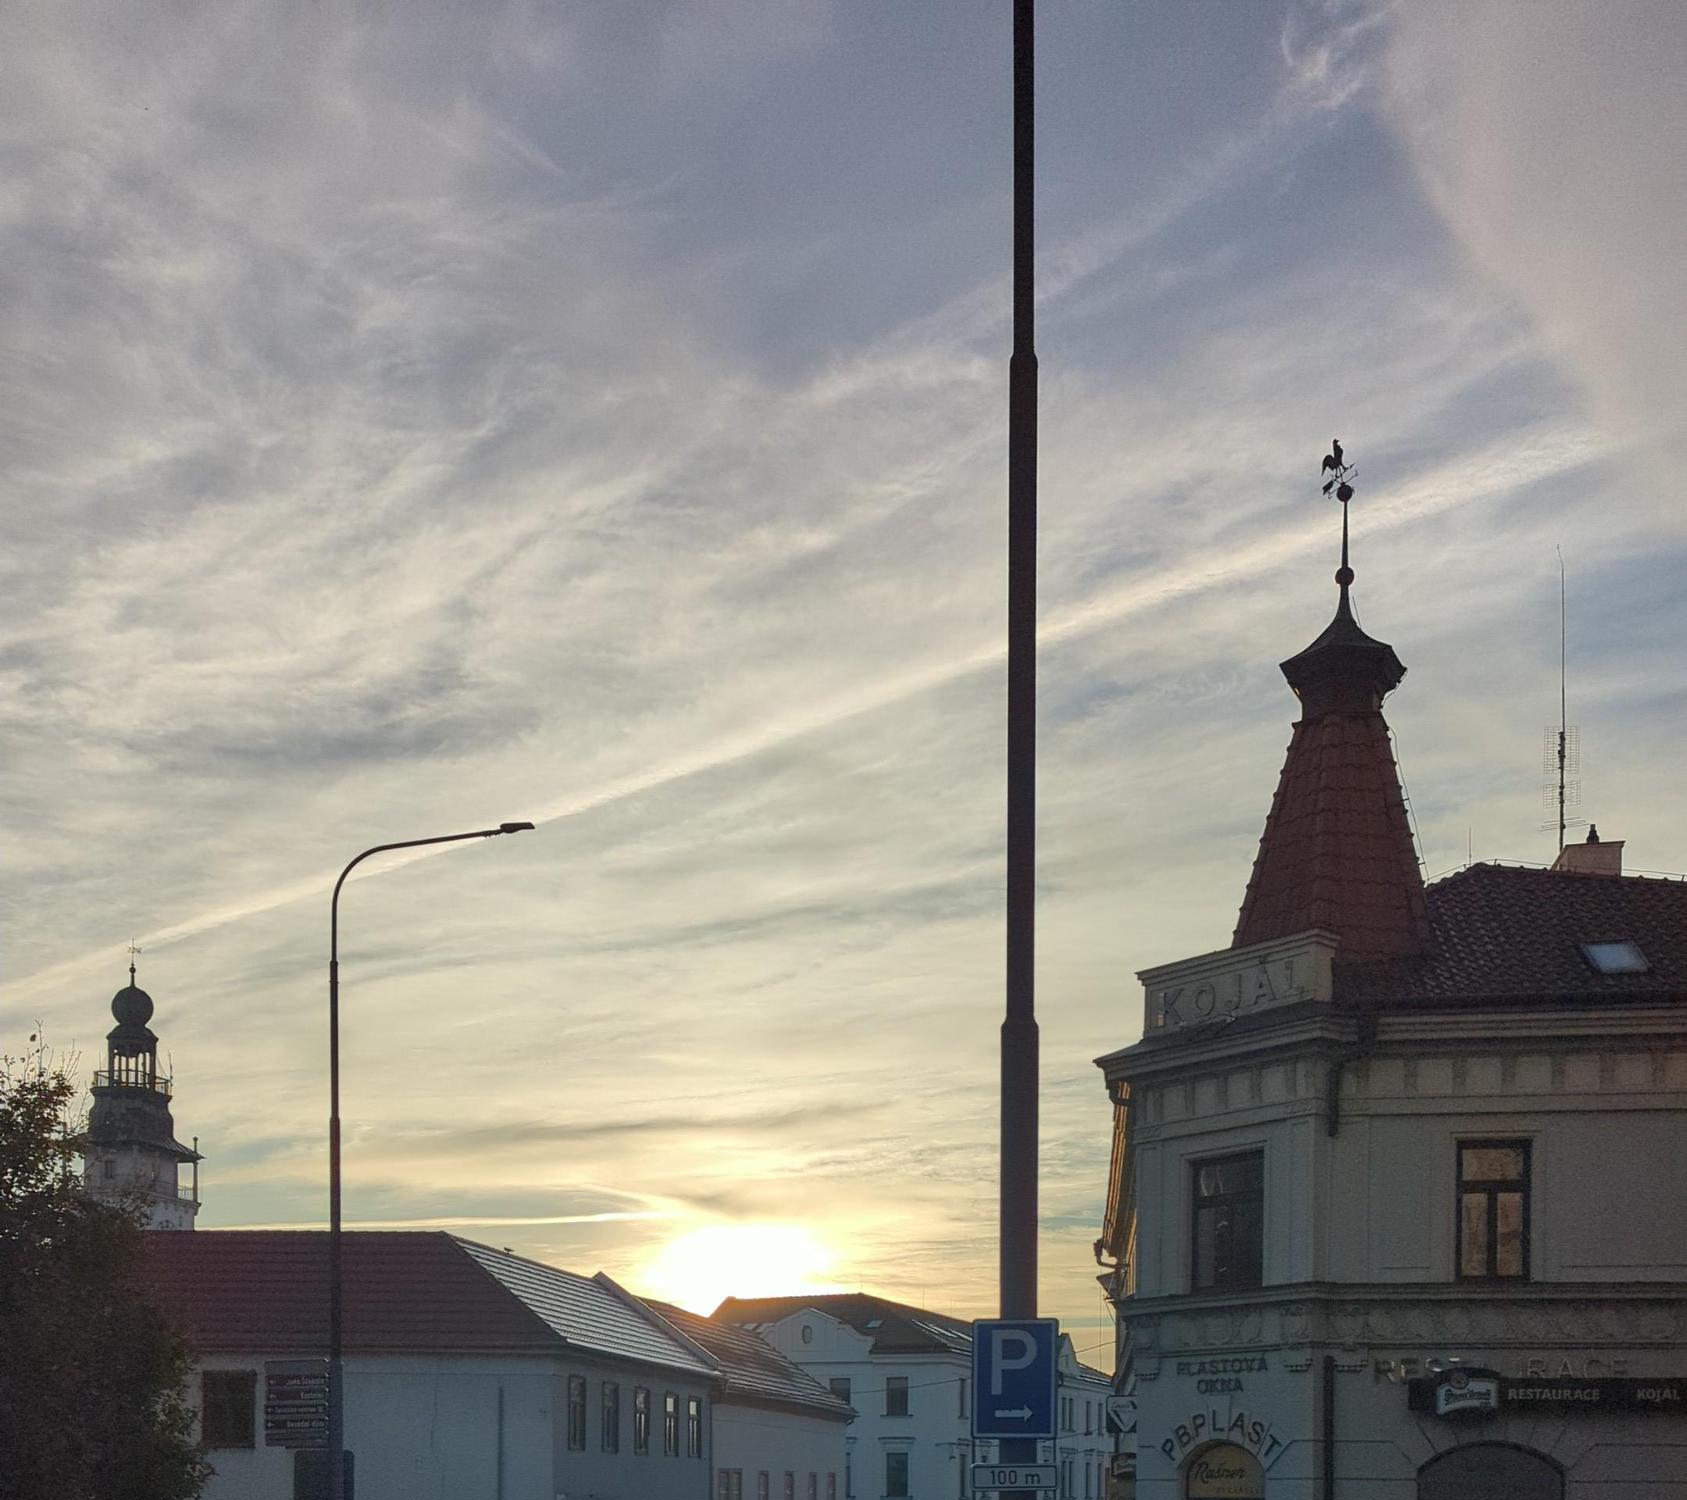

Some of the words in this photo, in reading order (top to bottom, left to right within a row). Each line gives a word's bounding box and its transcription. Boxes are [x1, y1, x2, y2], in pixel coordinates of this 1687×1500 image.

[991, 1329, 1038, 1395] P
[1197, 1377, 1244, 1394] OKNA
[1507, 1388, 1601, 1401] RESTAURACE
[990, 1470, 1017, 1486] 100
[1025, 1472, 1041, 1485] m
